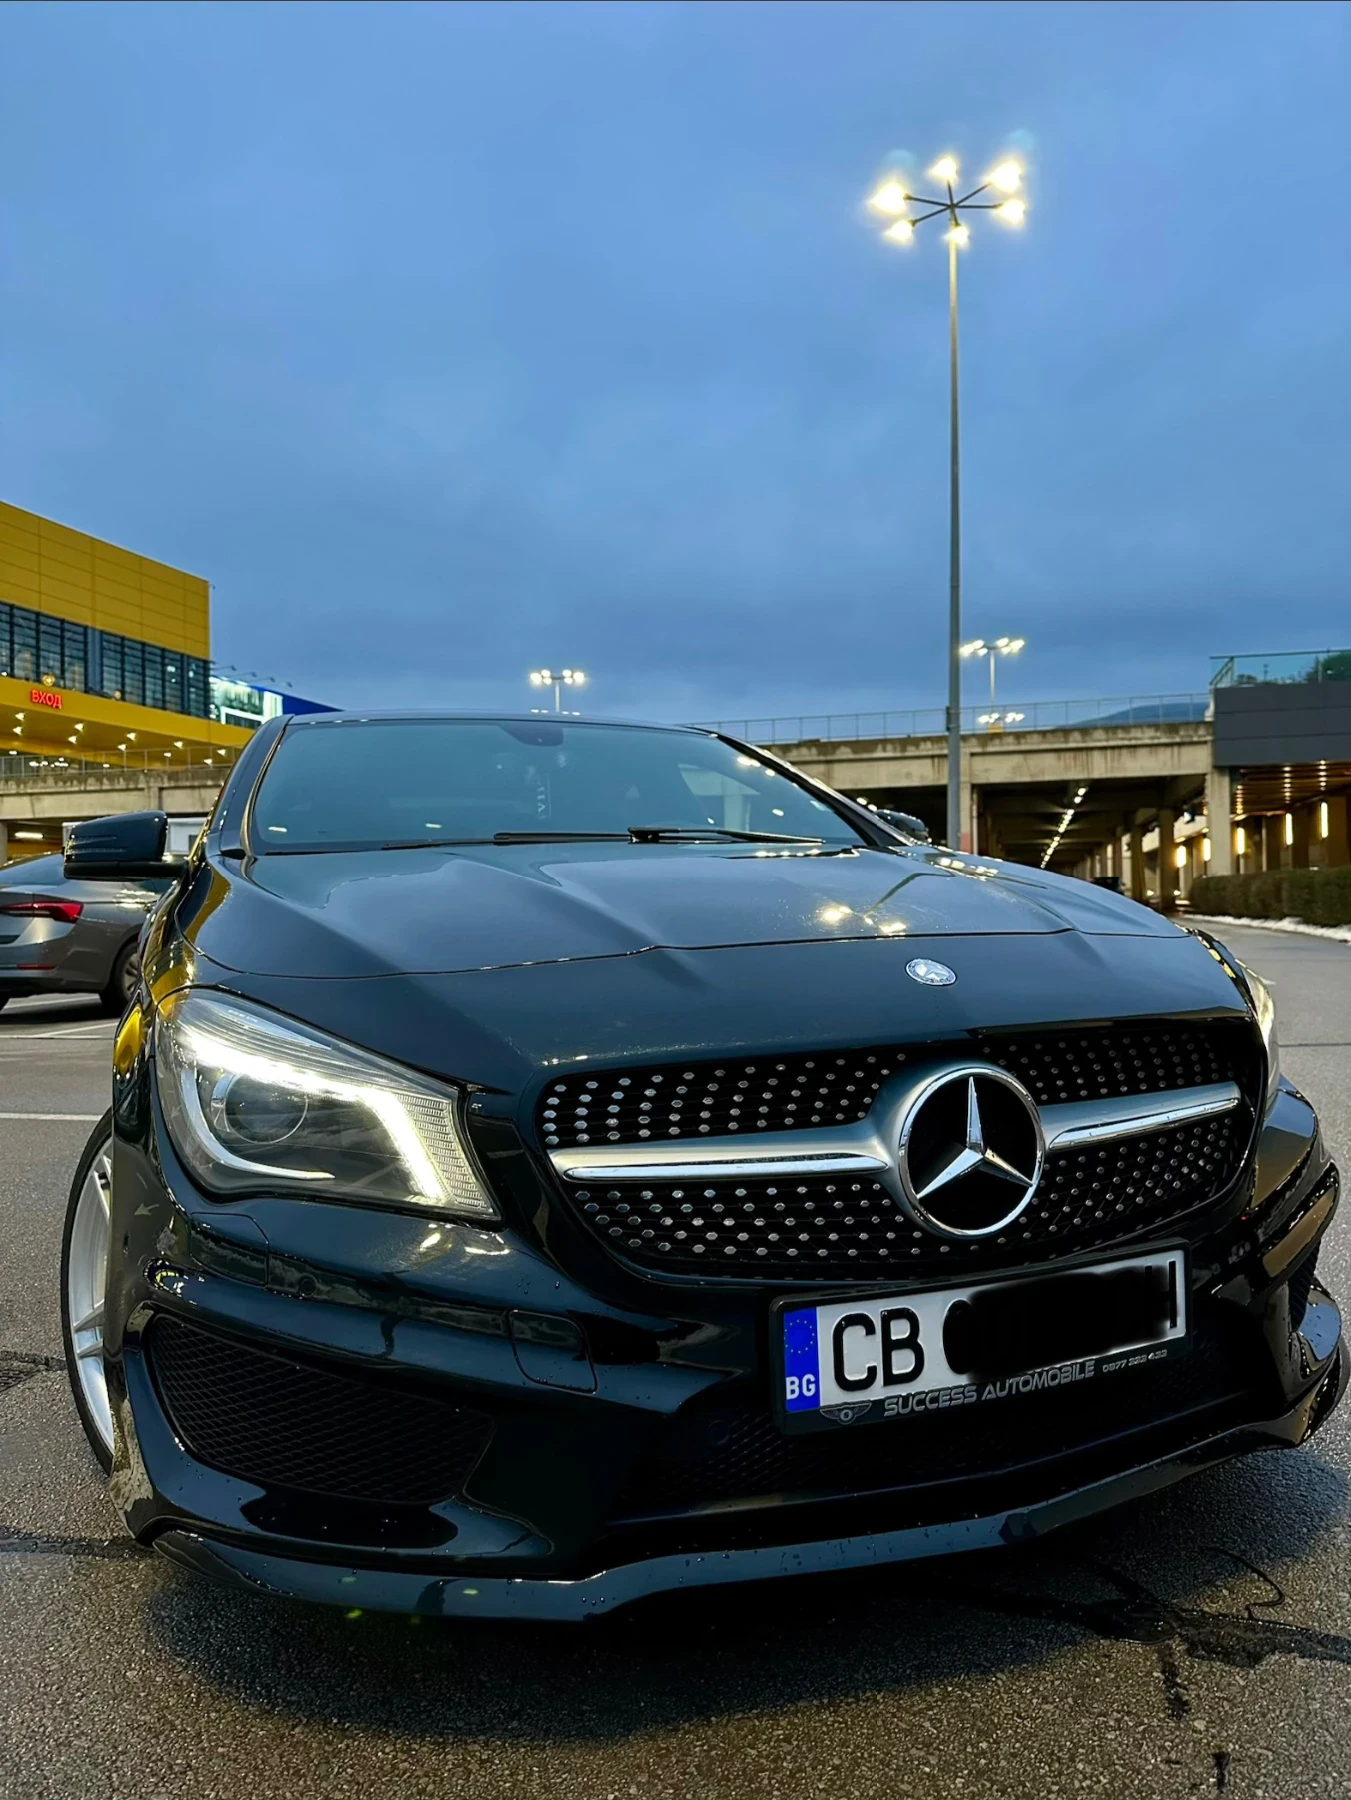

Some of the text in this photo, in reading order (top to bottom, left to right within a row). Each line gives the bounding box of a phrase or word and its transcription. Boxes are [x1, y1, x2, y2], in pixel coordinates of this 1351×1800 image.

[31, 689, 62, 709] ВХОД
[785, 1373, 816, 1400] BG
[883, 1384, 977, 1417] SUCCESS
[981, 1361, 1095, 1400] AUTOMOBILE
